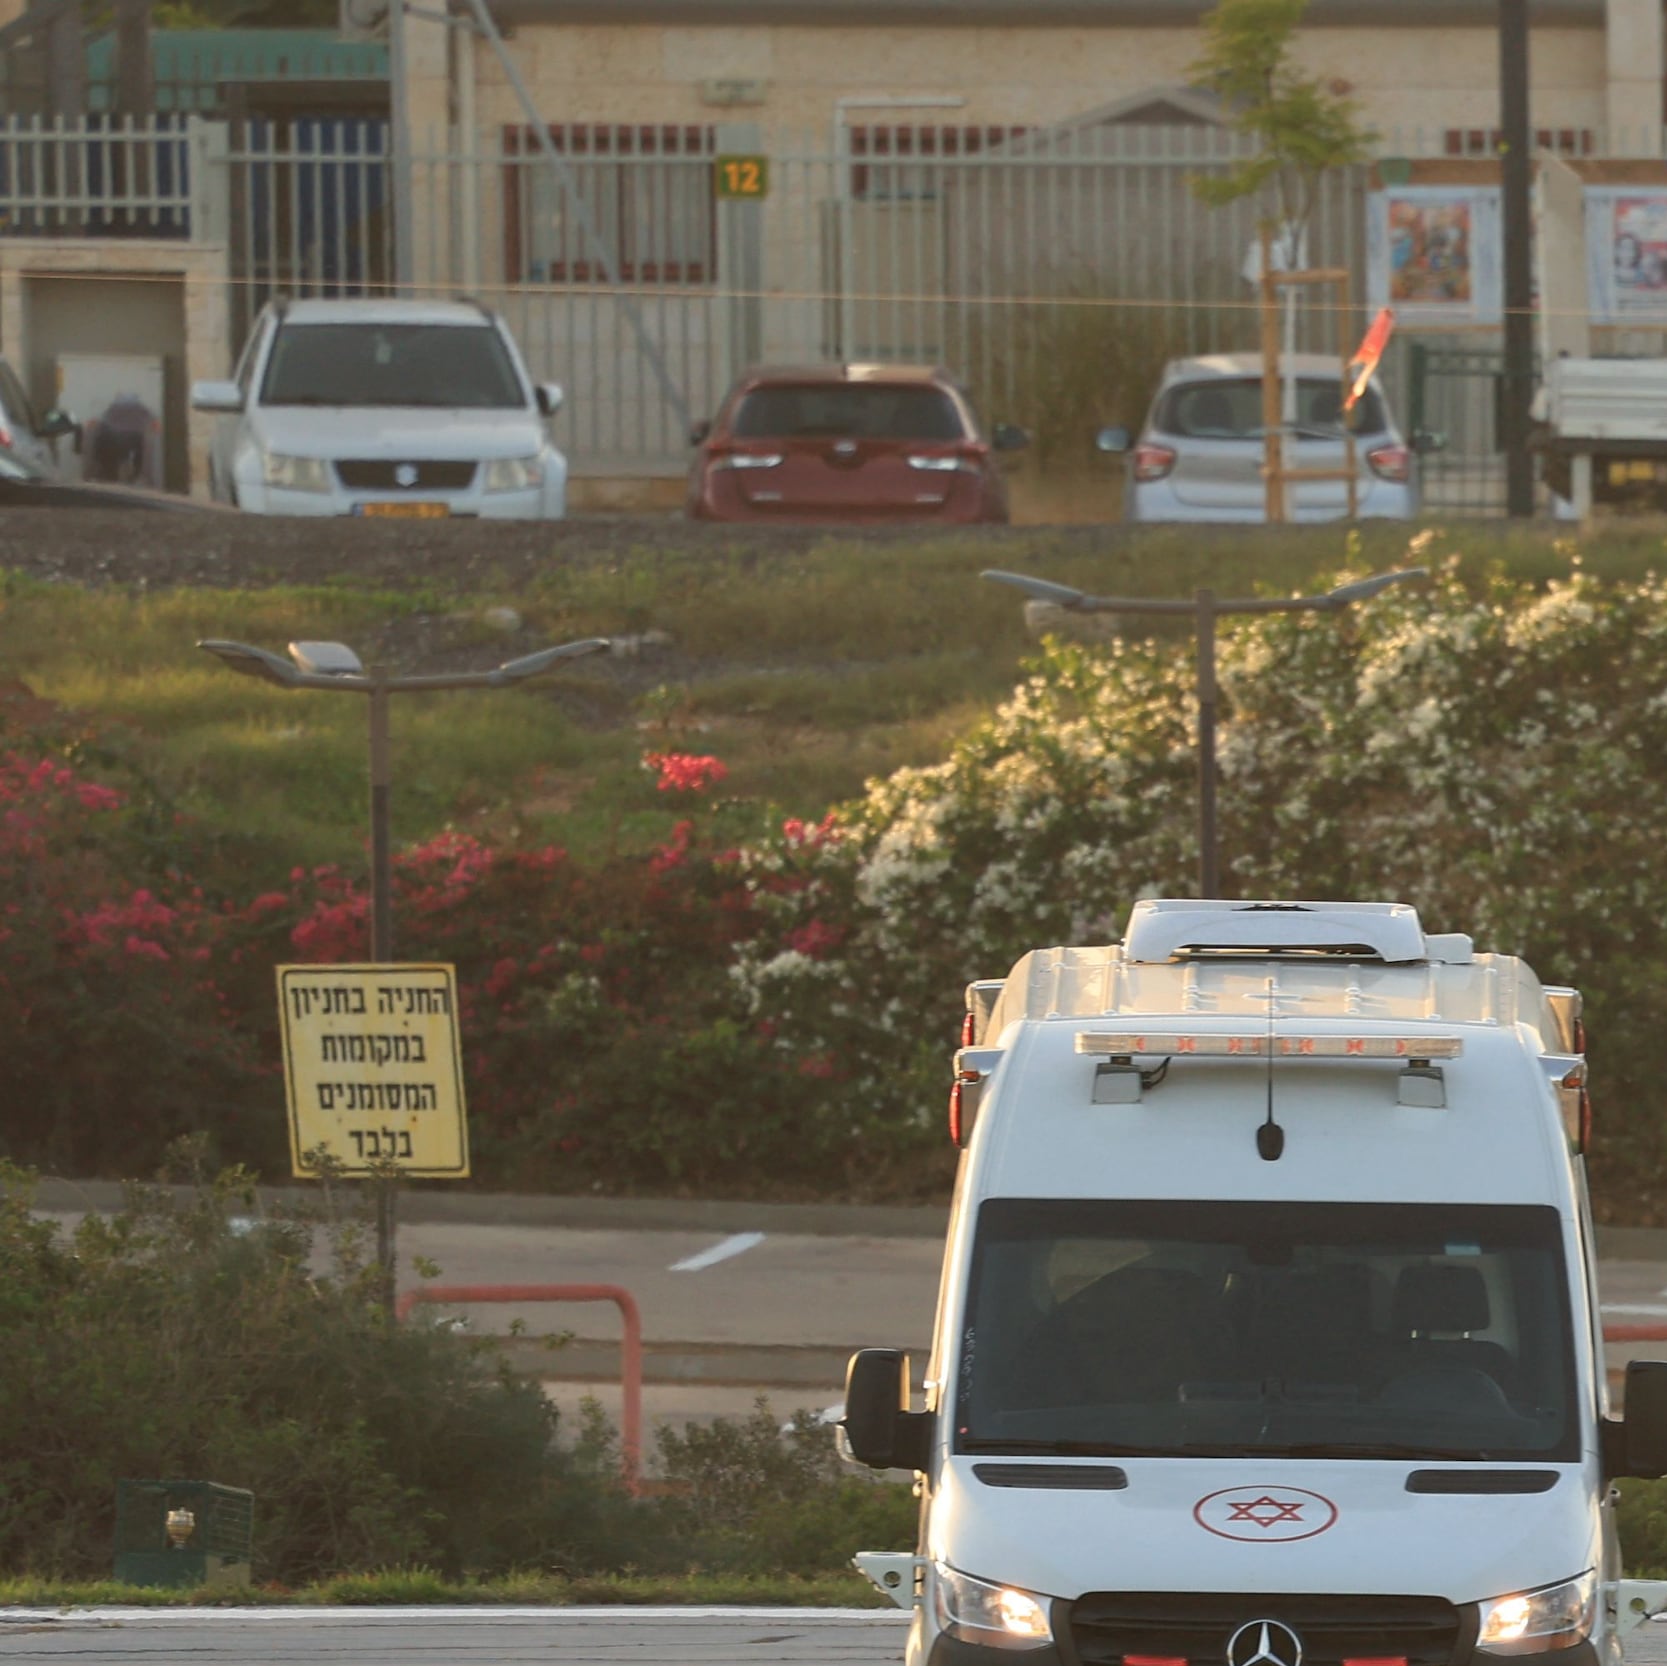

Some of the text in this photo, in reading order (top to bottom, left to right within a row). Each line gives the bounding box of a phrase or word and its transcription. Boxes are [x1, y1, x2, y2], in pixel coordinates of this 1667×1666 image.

[725, 162, 760, 193] 12
[290, 985, 450, 1019] החניה בחניון
[320, 1033, 427, 1067] במקומות
[316, 1082, 438, 1111] המסומנים
[348, 1126, 414, 1159] בלבד
